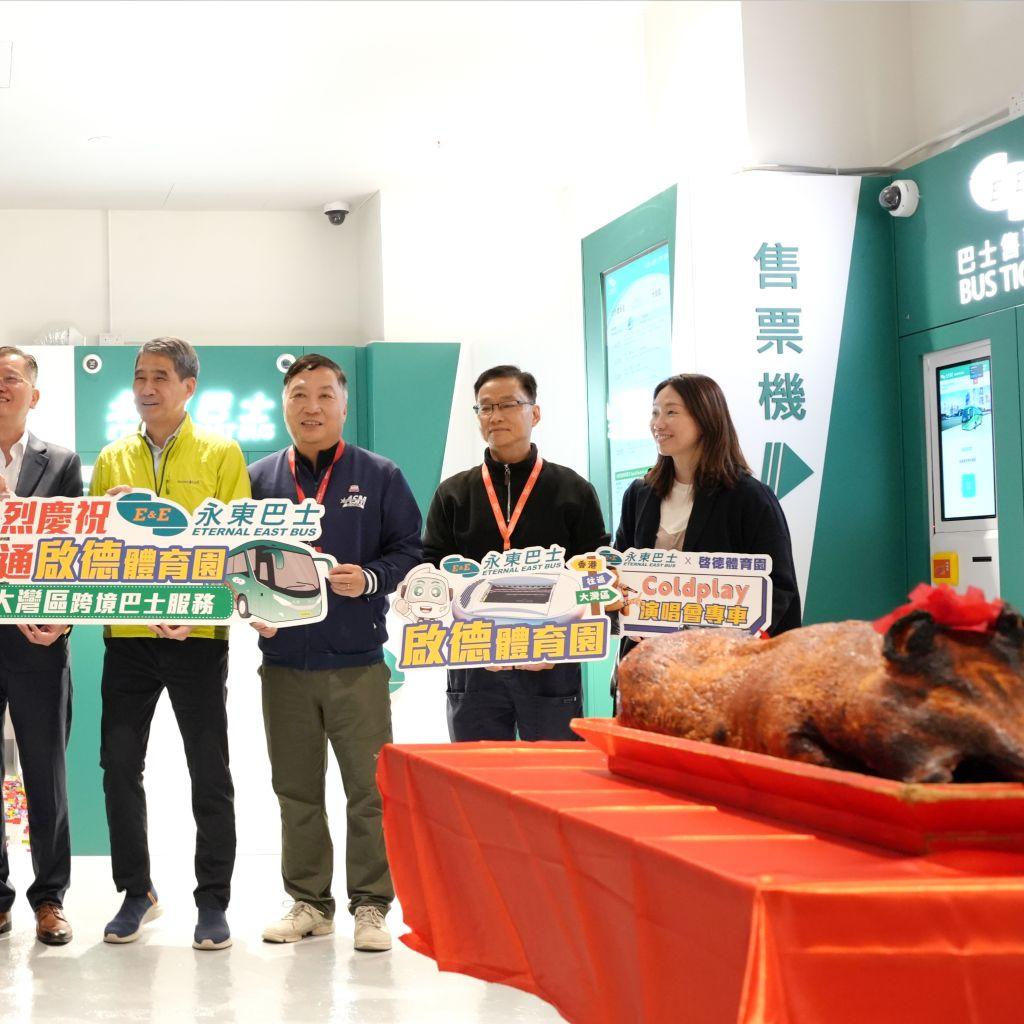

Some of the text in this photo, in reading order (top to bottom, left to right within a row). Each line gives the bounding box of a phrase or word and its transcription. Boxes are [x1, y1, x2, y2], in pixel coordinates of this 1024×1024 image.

[959, 268, 998, 304] BUS
[754, 242, 806, 420] 售票機
[133, 507, 171, 522] E&E
[194, 502, 320, 526] 永東巴士
[192, 528, 318, 536] ETERNAL EAST BUS
[484, 548, 562, 568] 永東巴士
[577, 560, 597, 569] 香港
[625, 552, 678, 563] 永東巴士
[482, 567, 519, 575] ETERNAL
[642, 576, 750, 604] Coldplay
[638, 600, 749, 626] 演唱會專車
[402, 620, 605, 666] 啟德體育園
